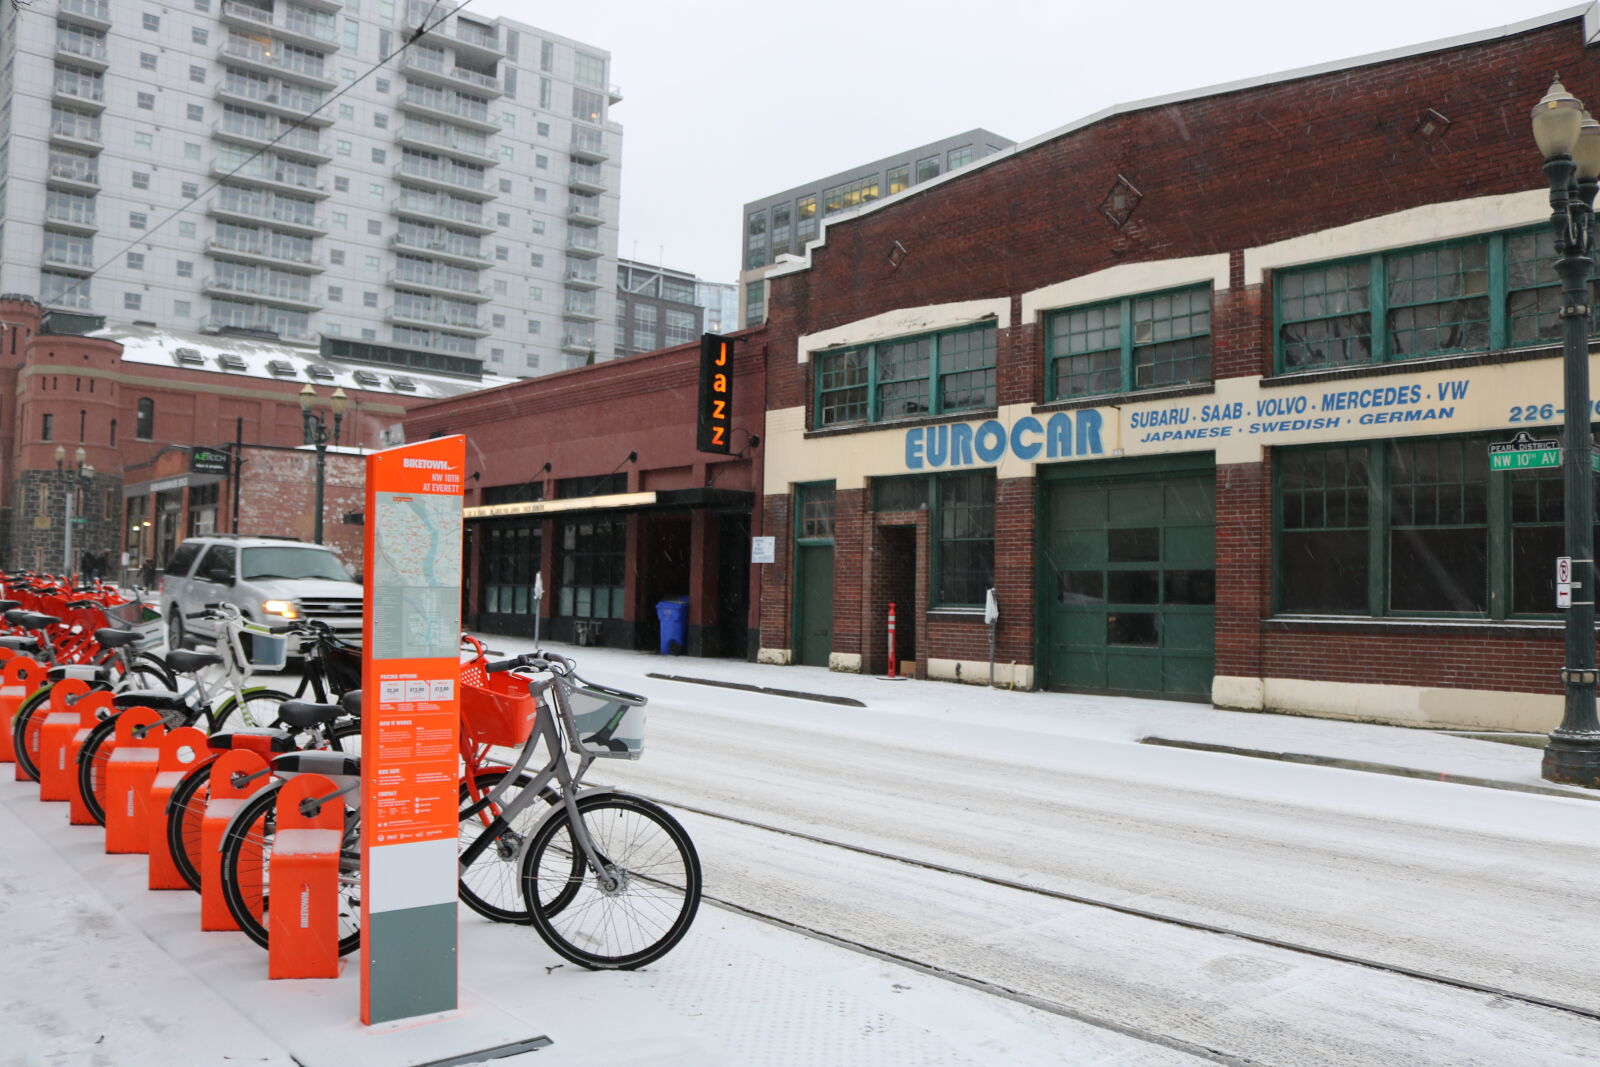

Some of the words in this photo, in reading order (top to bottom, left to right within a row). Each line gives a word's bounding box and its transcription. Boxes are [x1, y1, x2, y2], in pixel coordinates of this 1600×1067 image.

[712, 343, 726, 445] Jazz
[1130, 408, 1190, 429] SUBARU
[1201, 402, 1244, 422] SAAB
[1257, 396, 1307, 417] VOLVO
[1321, 384, 1422, 411] MERCEDES
[1438, 380, 1470, 401] VW
[1140, 426, 1232, 443] JAPANESE
[1248, 417, 1341, 434] SWEDISH
[1359, 407, 1455, 425] GERMAN
[905, 409, 1103, 470] EUROCAR
[1491, 444, 1517, 452] PEARL
[1520, 441, 1556, 450] DISTRICT
[403, 458, 448, 470] BIKETOWN
[1494, 455, 1511, 467] NW
[1541, 451, 1557, 464] AV
[432, 474, 442, 482] NW
[445, 474, 460, 482] 10TH
[432, 484, 460, 492] EVERETT
